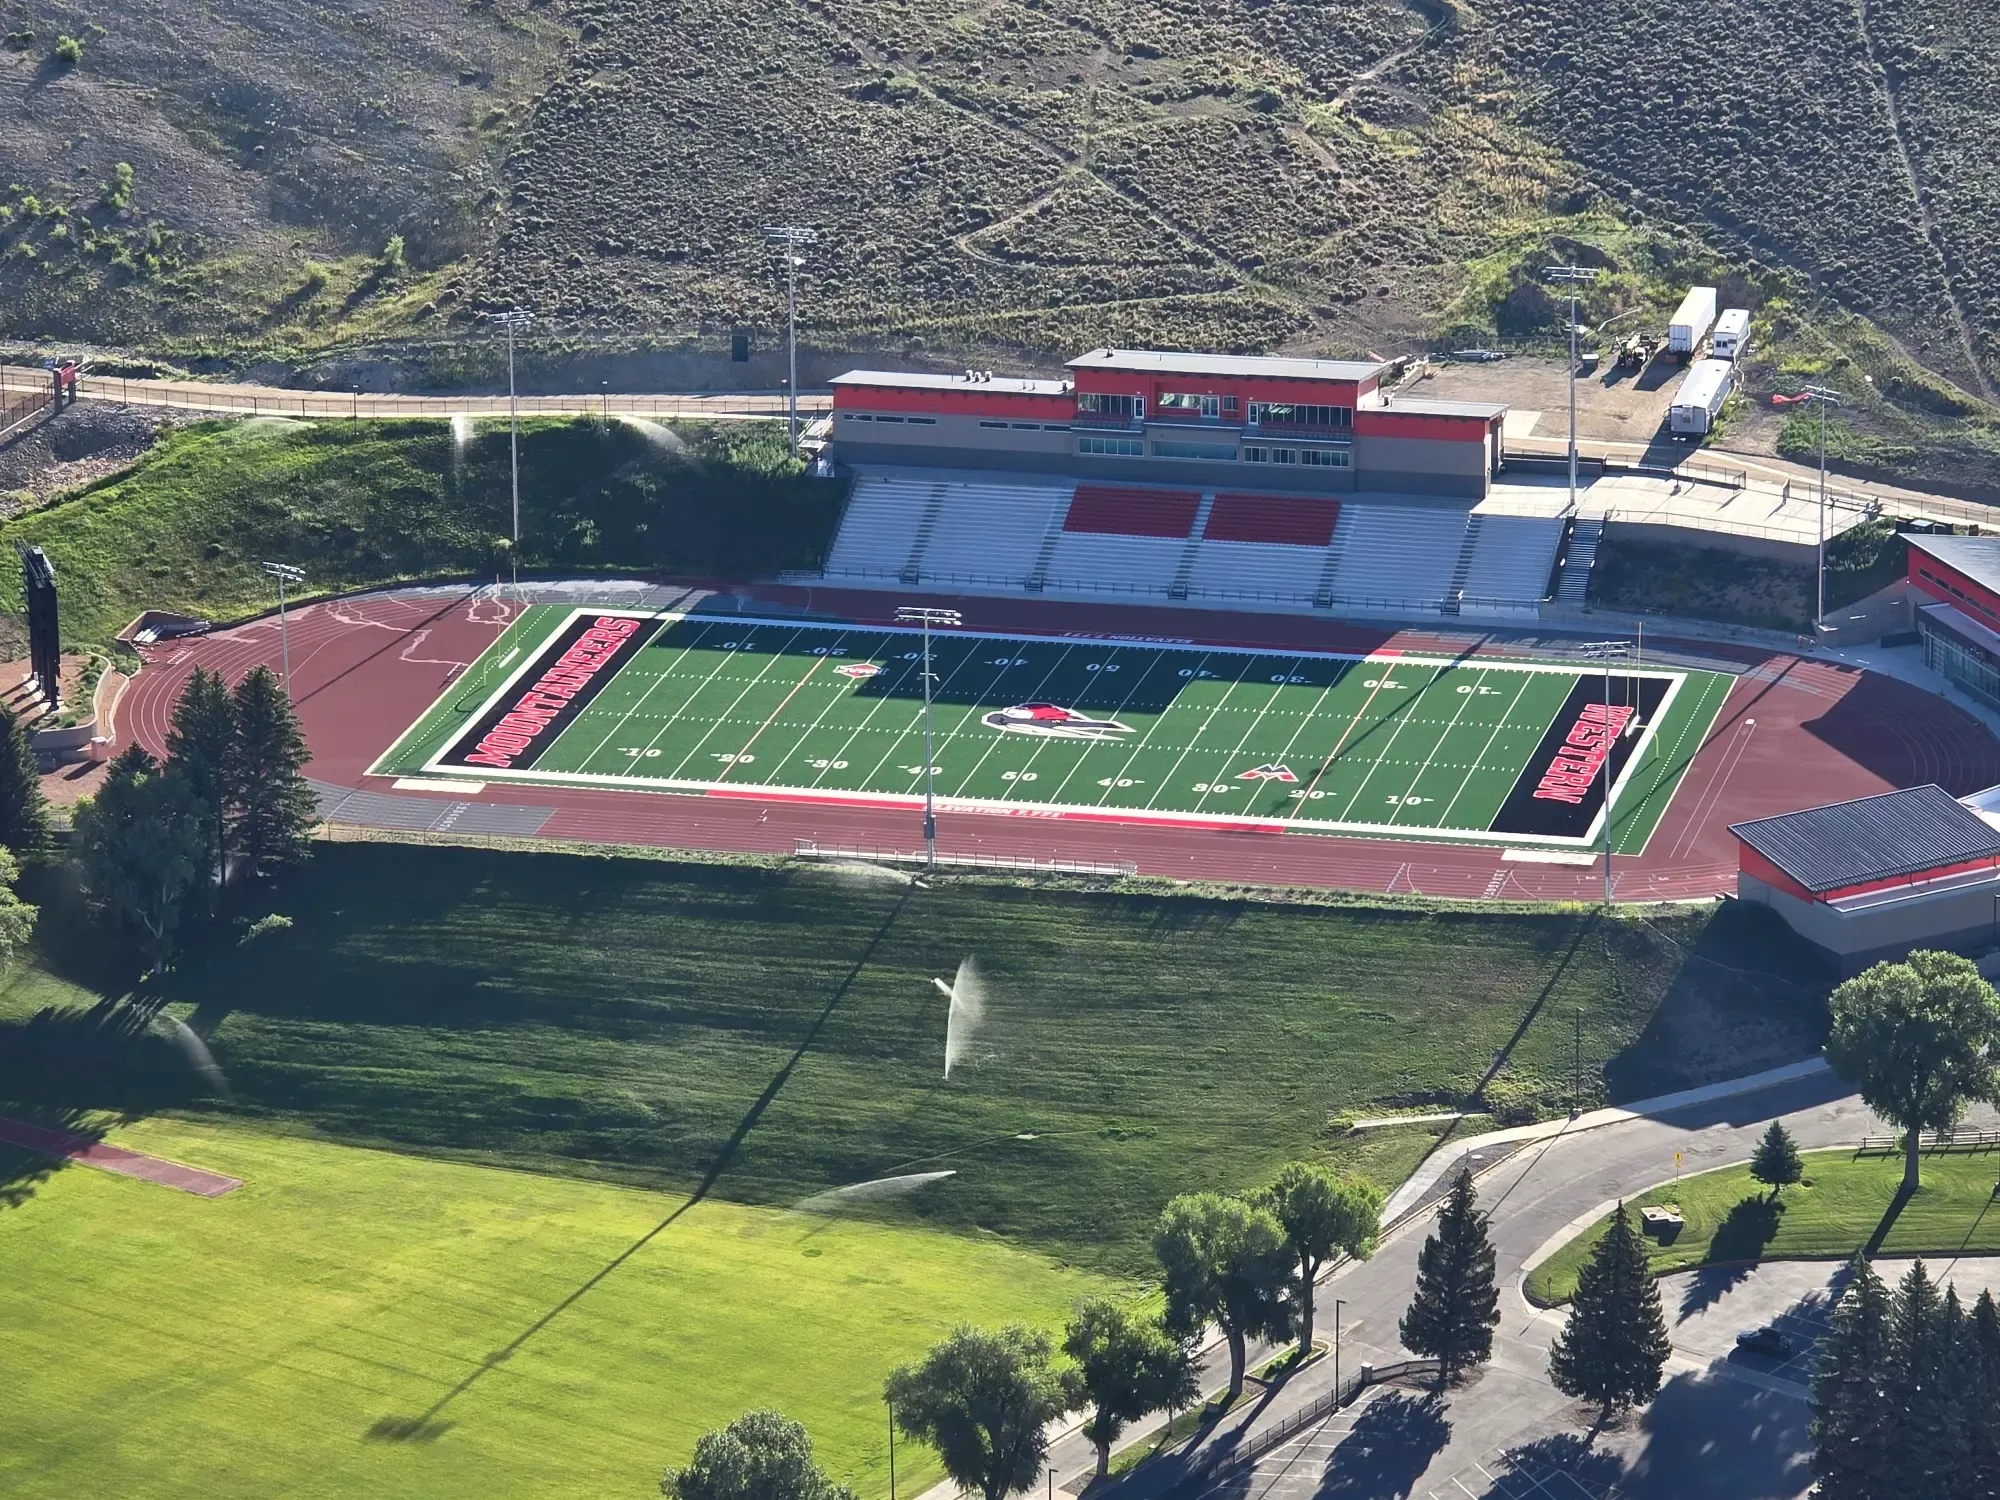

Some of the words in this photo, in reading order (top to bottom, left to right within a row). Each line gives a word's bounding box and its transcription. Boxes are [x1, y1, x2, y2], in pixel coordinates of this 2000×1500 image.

[1108, 635, 1194, 644] ELEVATION
[1086, 663, 1120, 672] 50
[464, 616, 641, 768] MOUNTAINEERS
[625, 748, 662, 758] 10
[1533, 704, 1634, 804] WESTERN
[718, 753, 755, 764] 20
[812, 759, 849, 770] 30
[906, 766, 943, 775] 40
[1001, 771, 1038, 781] 50
[1096, 777, 1133, 787] 40
[1191, 783, 1229, 793] 30
[1288, 789, 1325, 800] 20
[1385, 795, 1422, 806] 10
